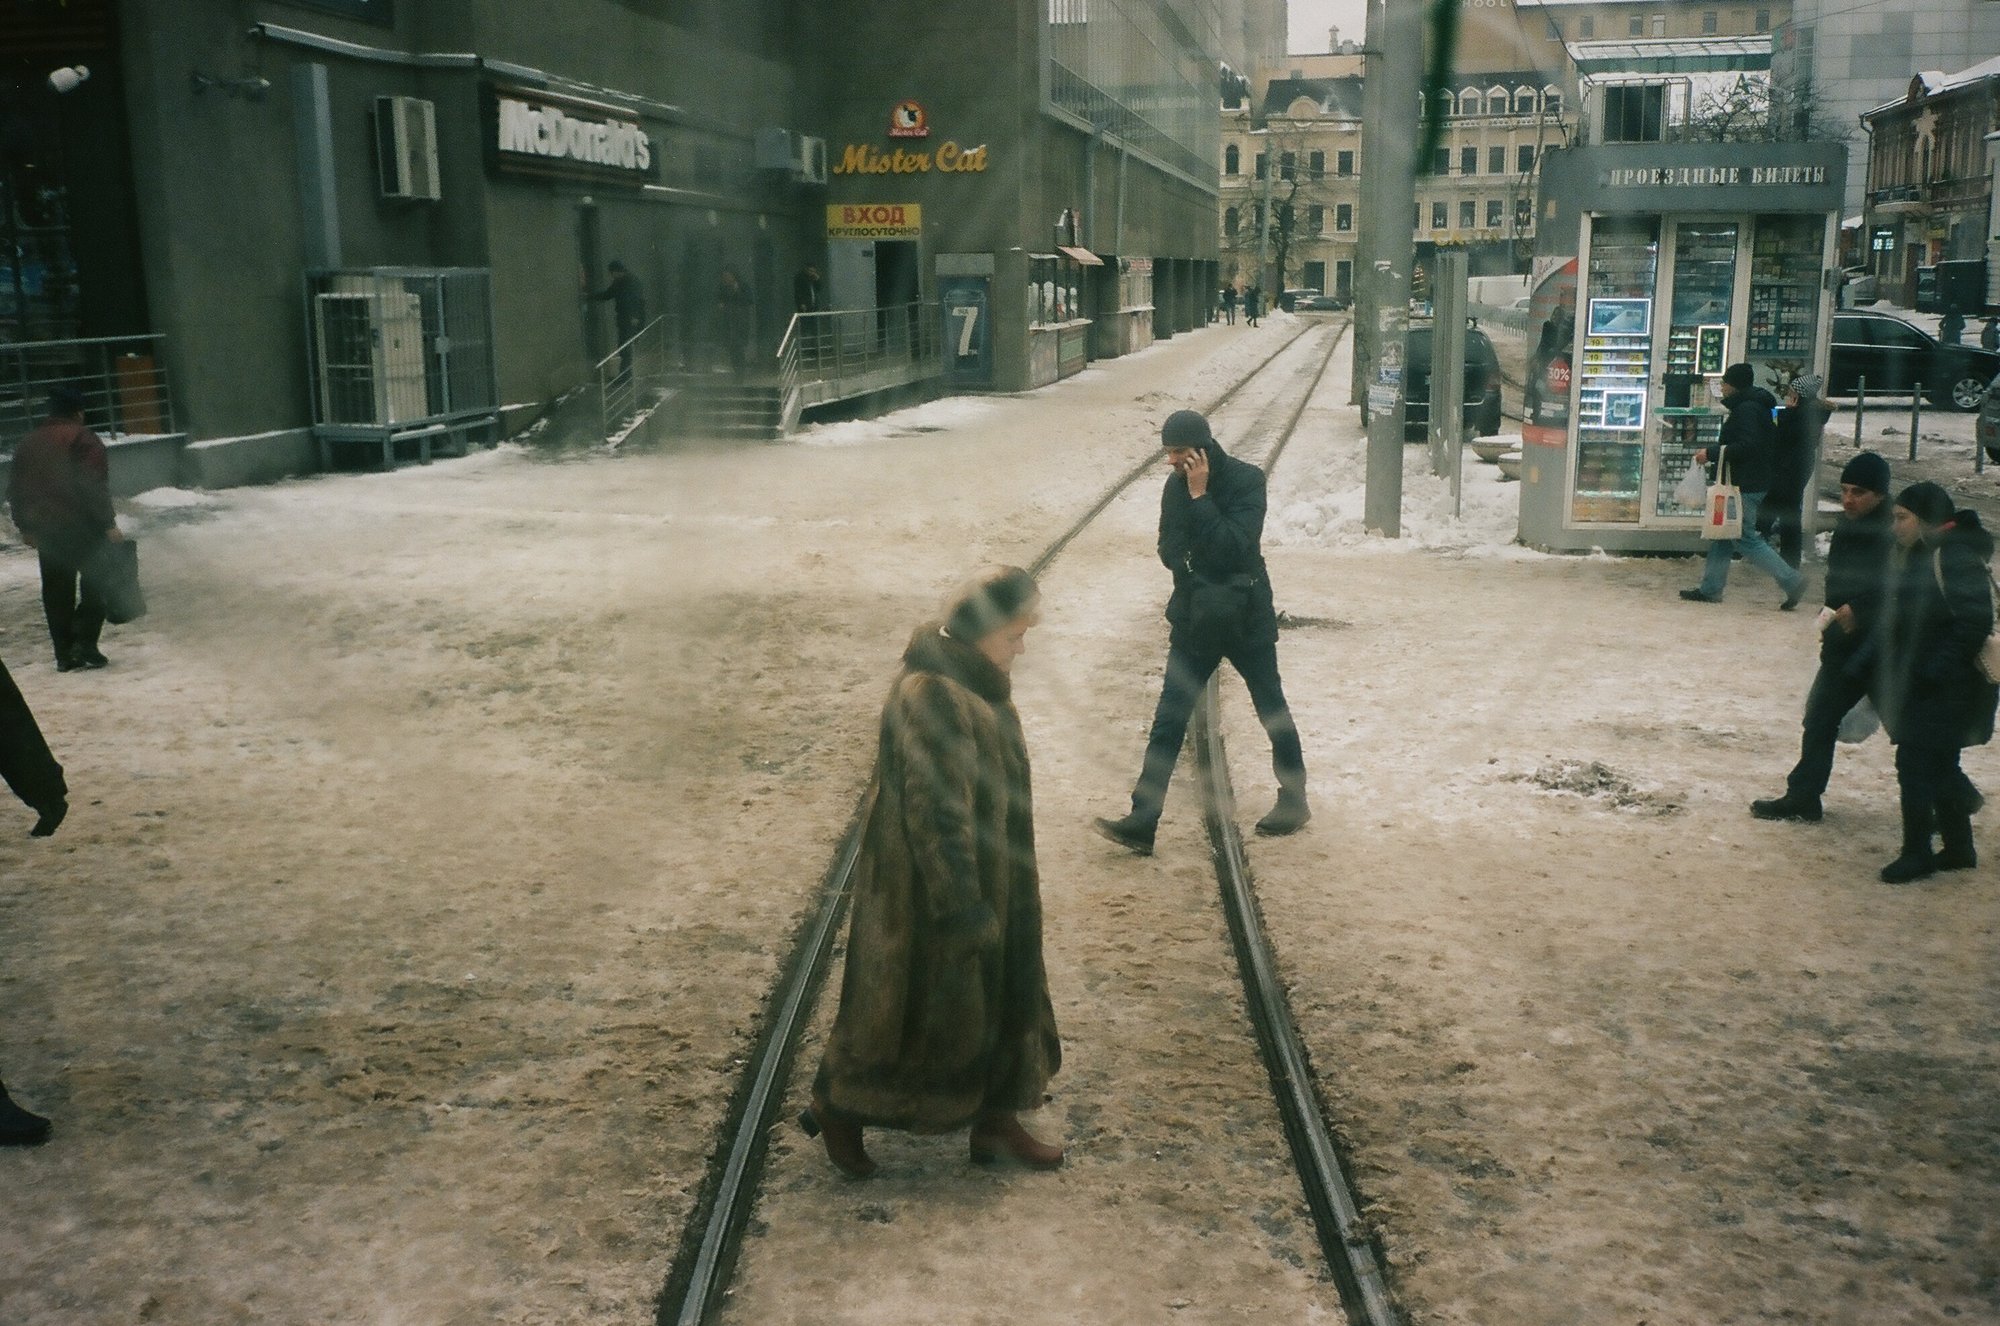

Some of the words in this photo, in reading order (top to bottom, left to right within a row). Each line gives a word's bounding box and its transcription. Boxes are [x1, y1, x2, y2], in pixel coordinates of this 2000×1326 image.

[498, 98, 650, 170] McDonald's
[833, 143, 931, 175] Mister
[935, 140, 988, 172] Cat
[1610, 167, 1740, 187] ПРОЕЗДНЫЕ
[1752, 166, 1825, 184] БИЛЕТЫ
[843, 206, 905, 226] ВХОД
[828, 227, 920, 237] КРУГЛОСУТОЧНО
[952, 306, 979, 356] 7
[1547, 367, 1570, 381] 30%
